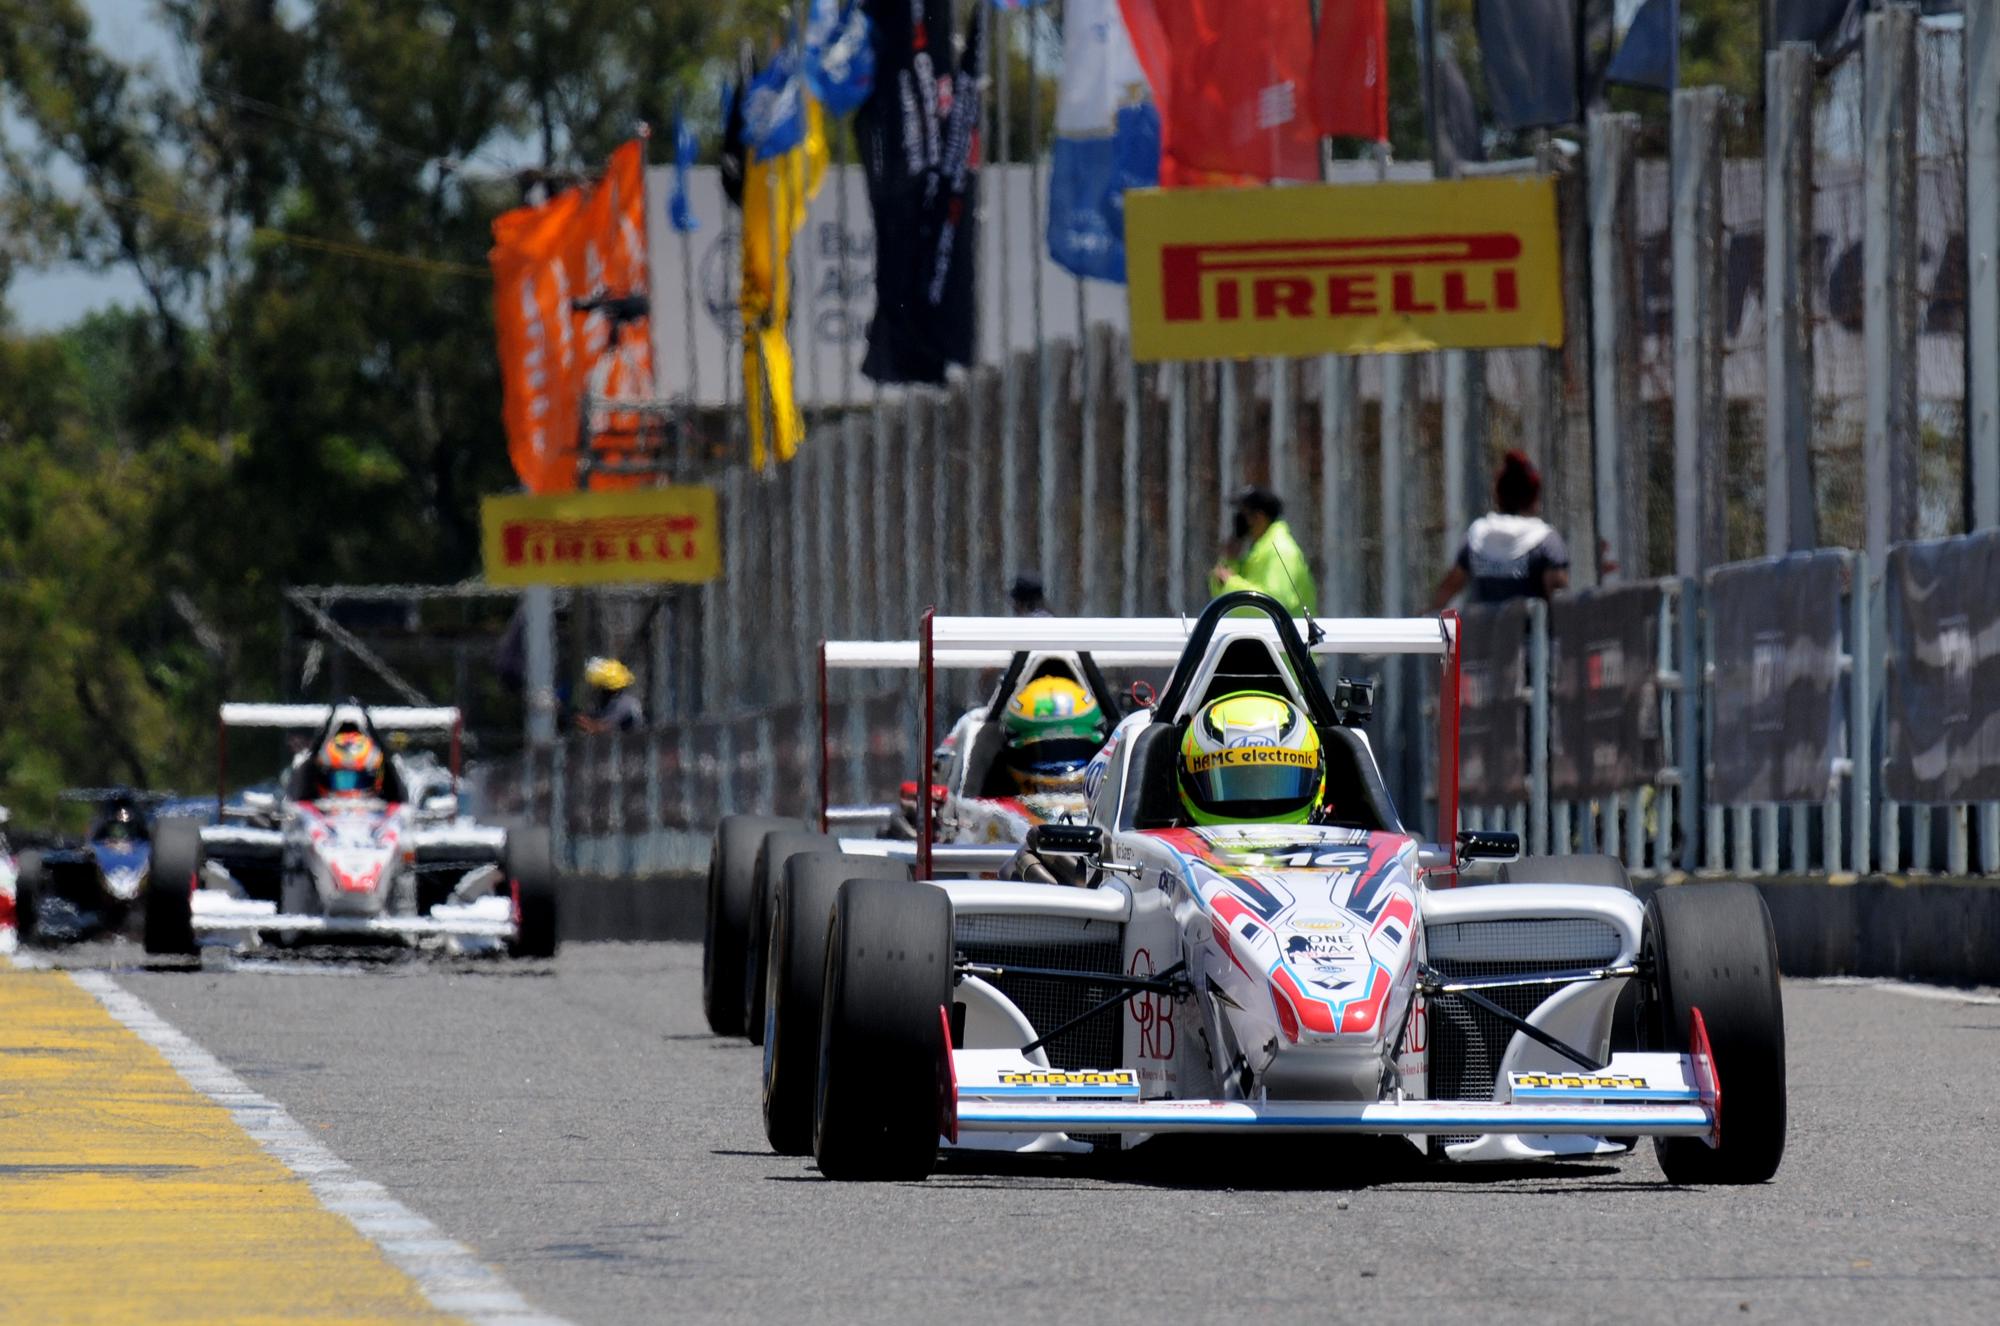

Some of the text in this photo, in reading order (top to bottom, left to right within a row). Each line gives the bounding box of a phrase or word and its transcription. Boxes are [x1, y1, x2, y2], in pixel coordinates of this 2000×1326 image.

[1162, 233, 1521, 321] PIRELLI
[503, 515, 695, 567] PIRELLI
[1241, 749, 1313, 765] electronic
[1308, 935, 1352, 944] ONE
[1308, 945, 1354, 953] WAY
